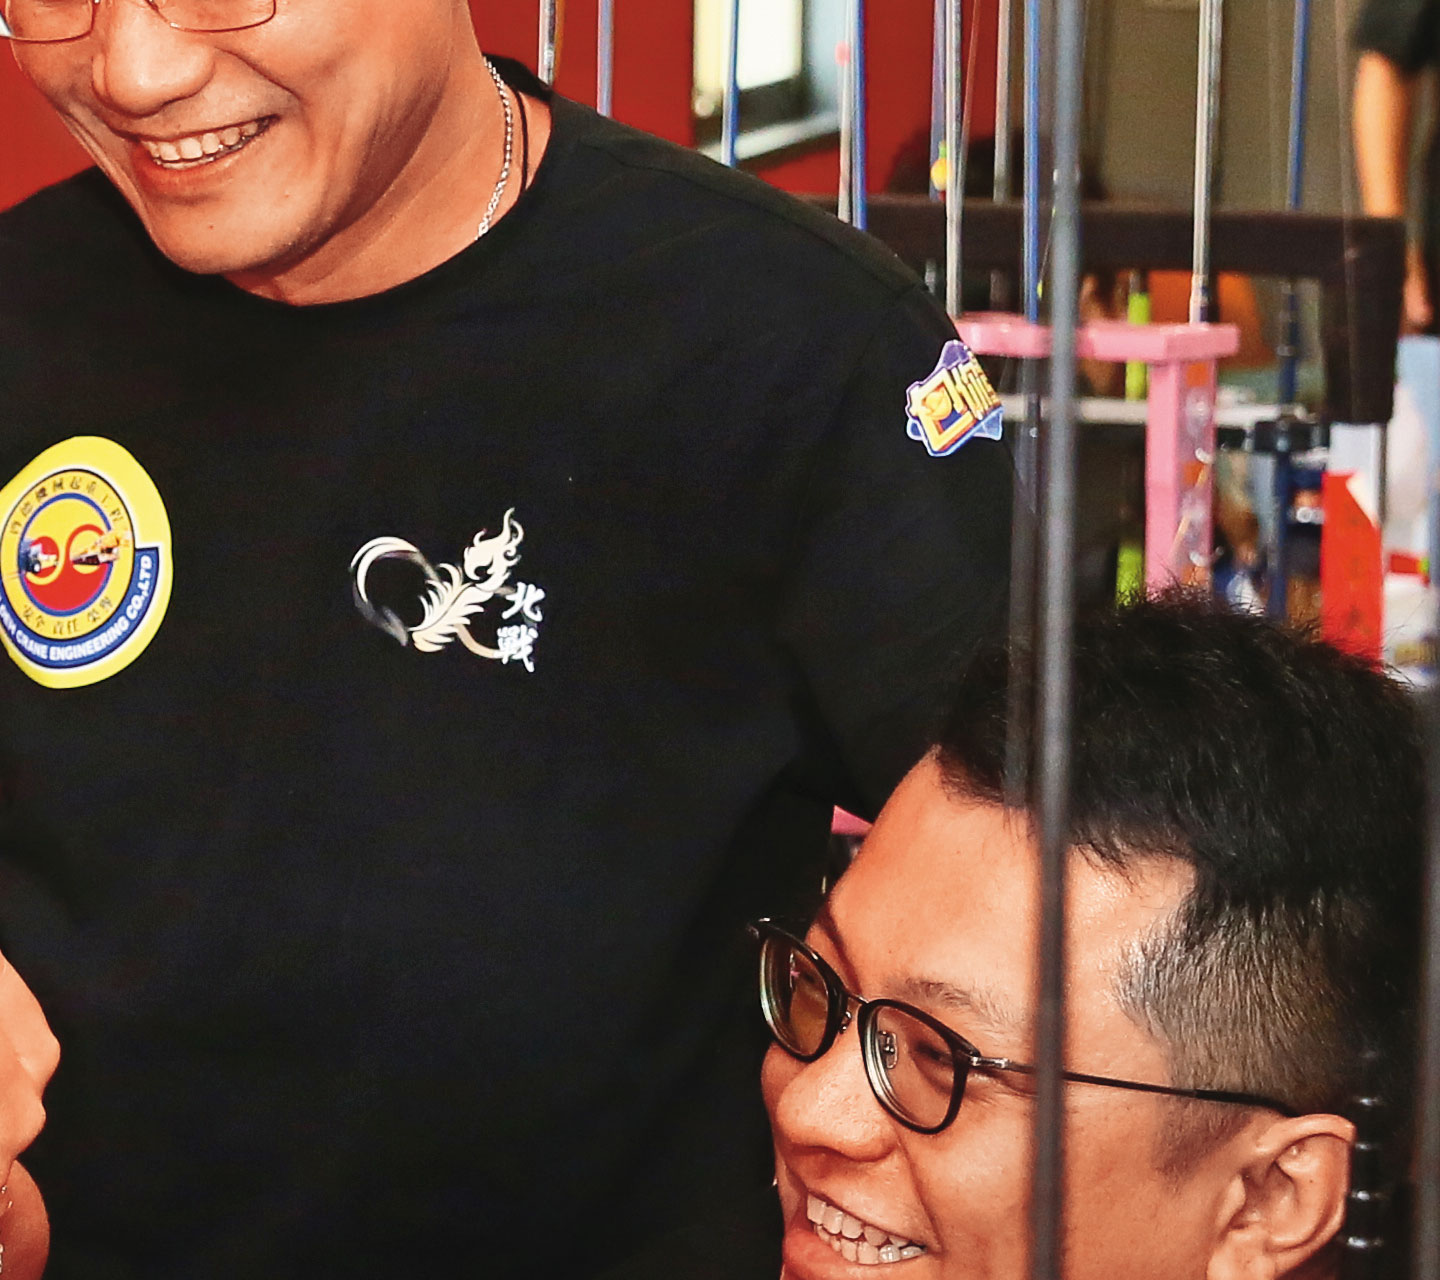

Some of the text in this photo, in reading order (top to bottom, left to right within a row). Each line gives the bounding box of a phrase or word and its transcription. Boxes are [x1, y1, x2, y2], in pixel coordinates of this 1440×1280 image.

[908, 351, 1000, 450] 包你
[16, 631, 48, 659] CRANE
[49, 617, 129, 660] ENGINEERING
